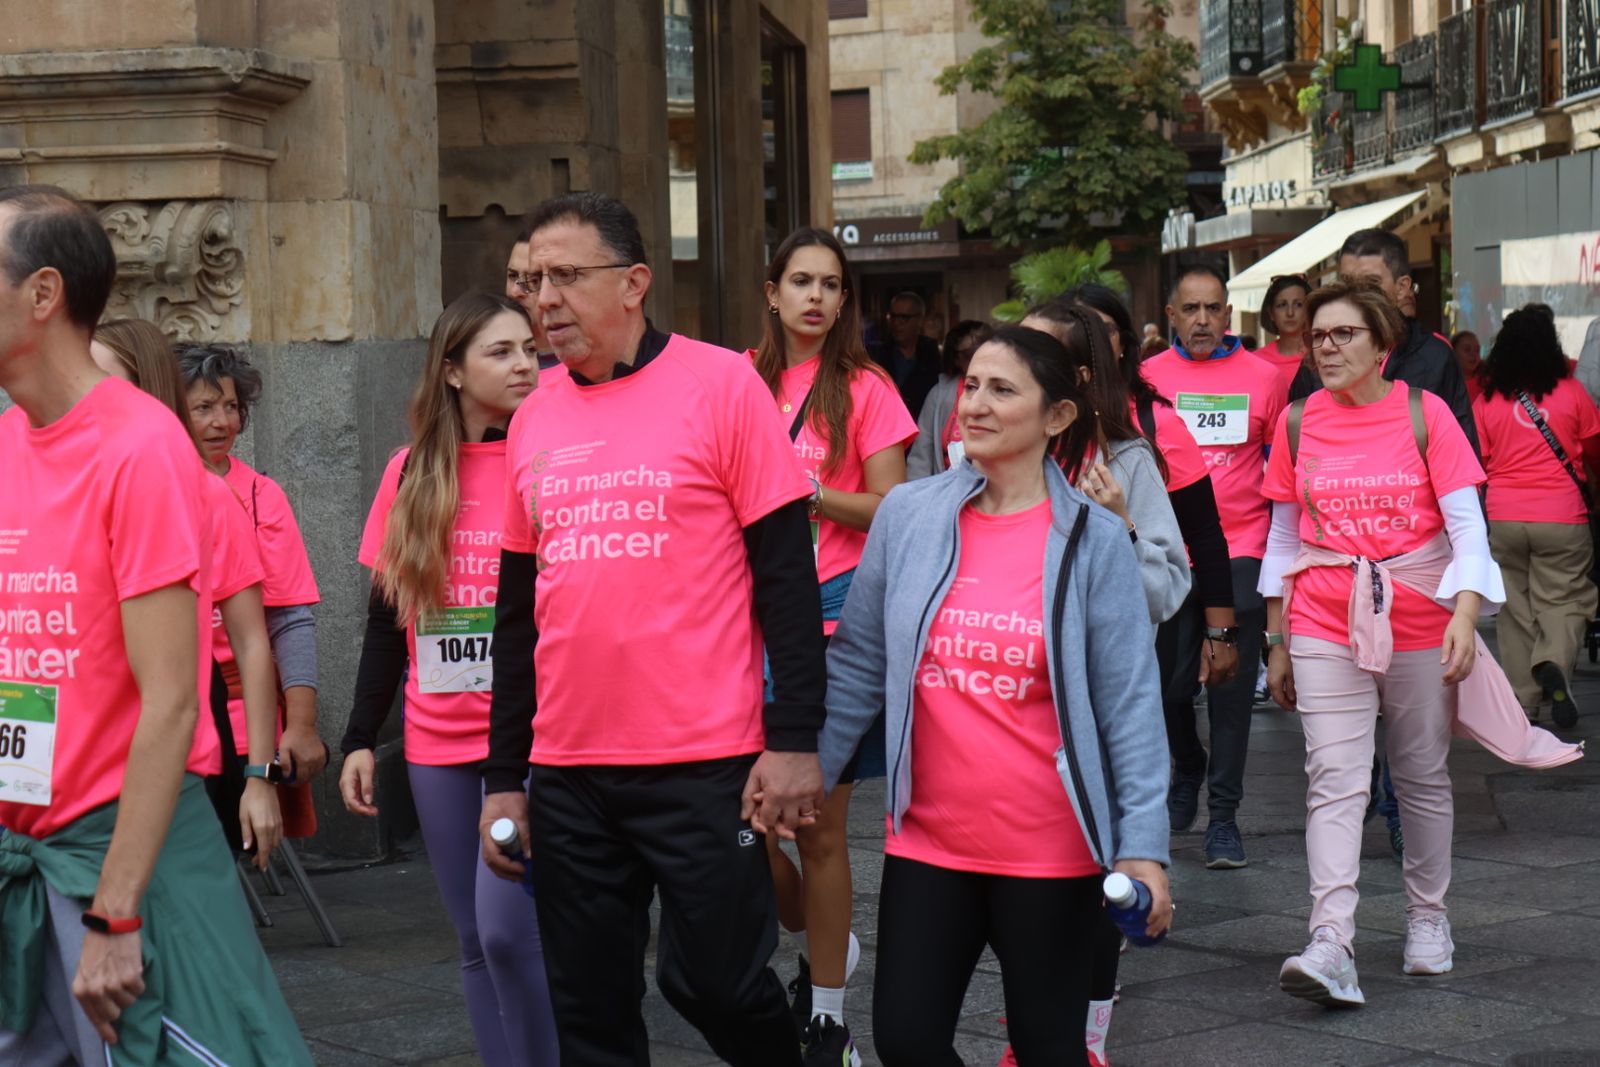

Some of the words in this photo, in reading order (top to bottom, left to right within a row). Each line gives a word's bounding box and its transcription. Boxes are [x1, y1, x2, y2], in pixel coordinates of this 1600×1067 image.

[873, 231, 939, 242] ACCESSORIES
[1197, 412, 1227, 428] 243
[541, 475, 569, 497] En
[575, 464, 672, 493] marcha
[1313, 476, 1339, 491] En
[1344, 470, 1421, 488] marcha
[541, 497, 631, 530] contra
[634, 494, 668, 522] el
[1316, 492, 1394, 513] contra
[1396, 490, 1416, 509] el
[1325, 513, 1420, 537] cáncer
[544, 527, 670, 565] cáncer
[6, 565, 78, 593] marcha
[46, 602, 77, 635] el
[939, 607, 1043, 637] marcha
[437, 637, 493, 663] 1047
[1003, 642, 1036, 669] el
[916, 656, 1035, 701] áncer
